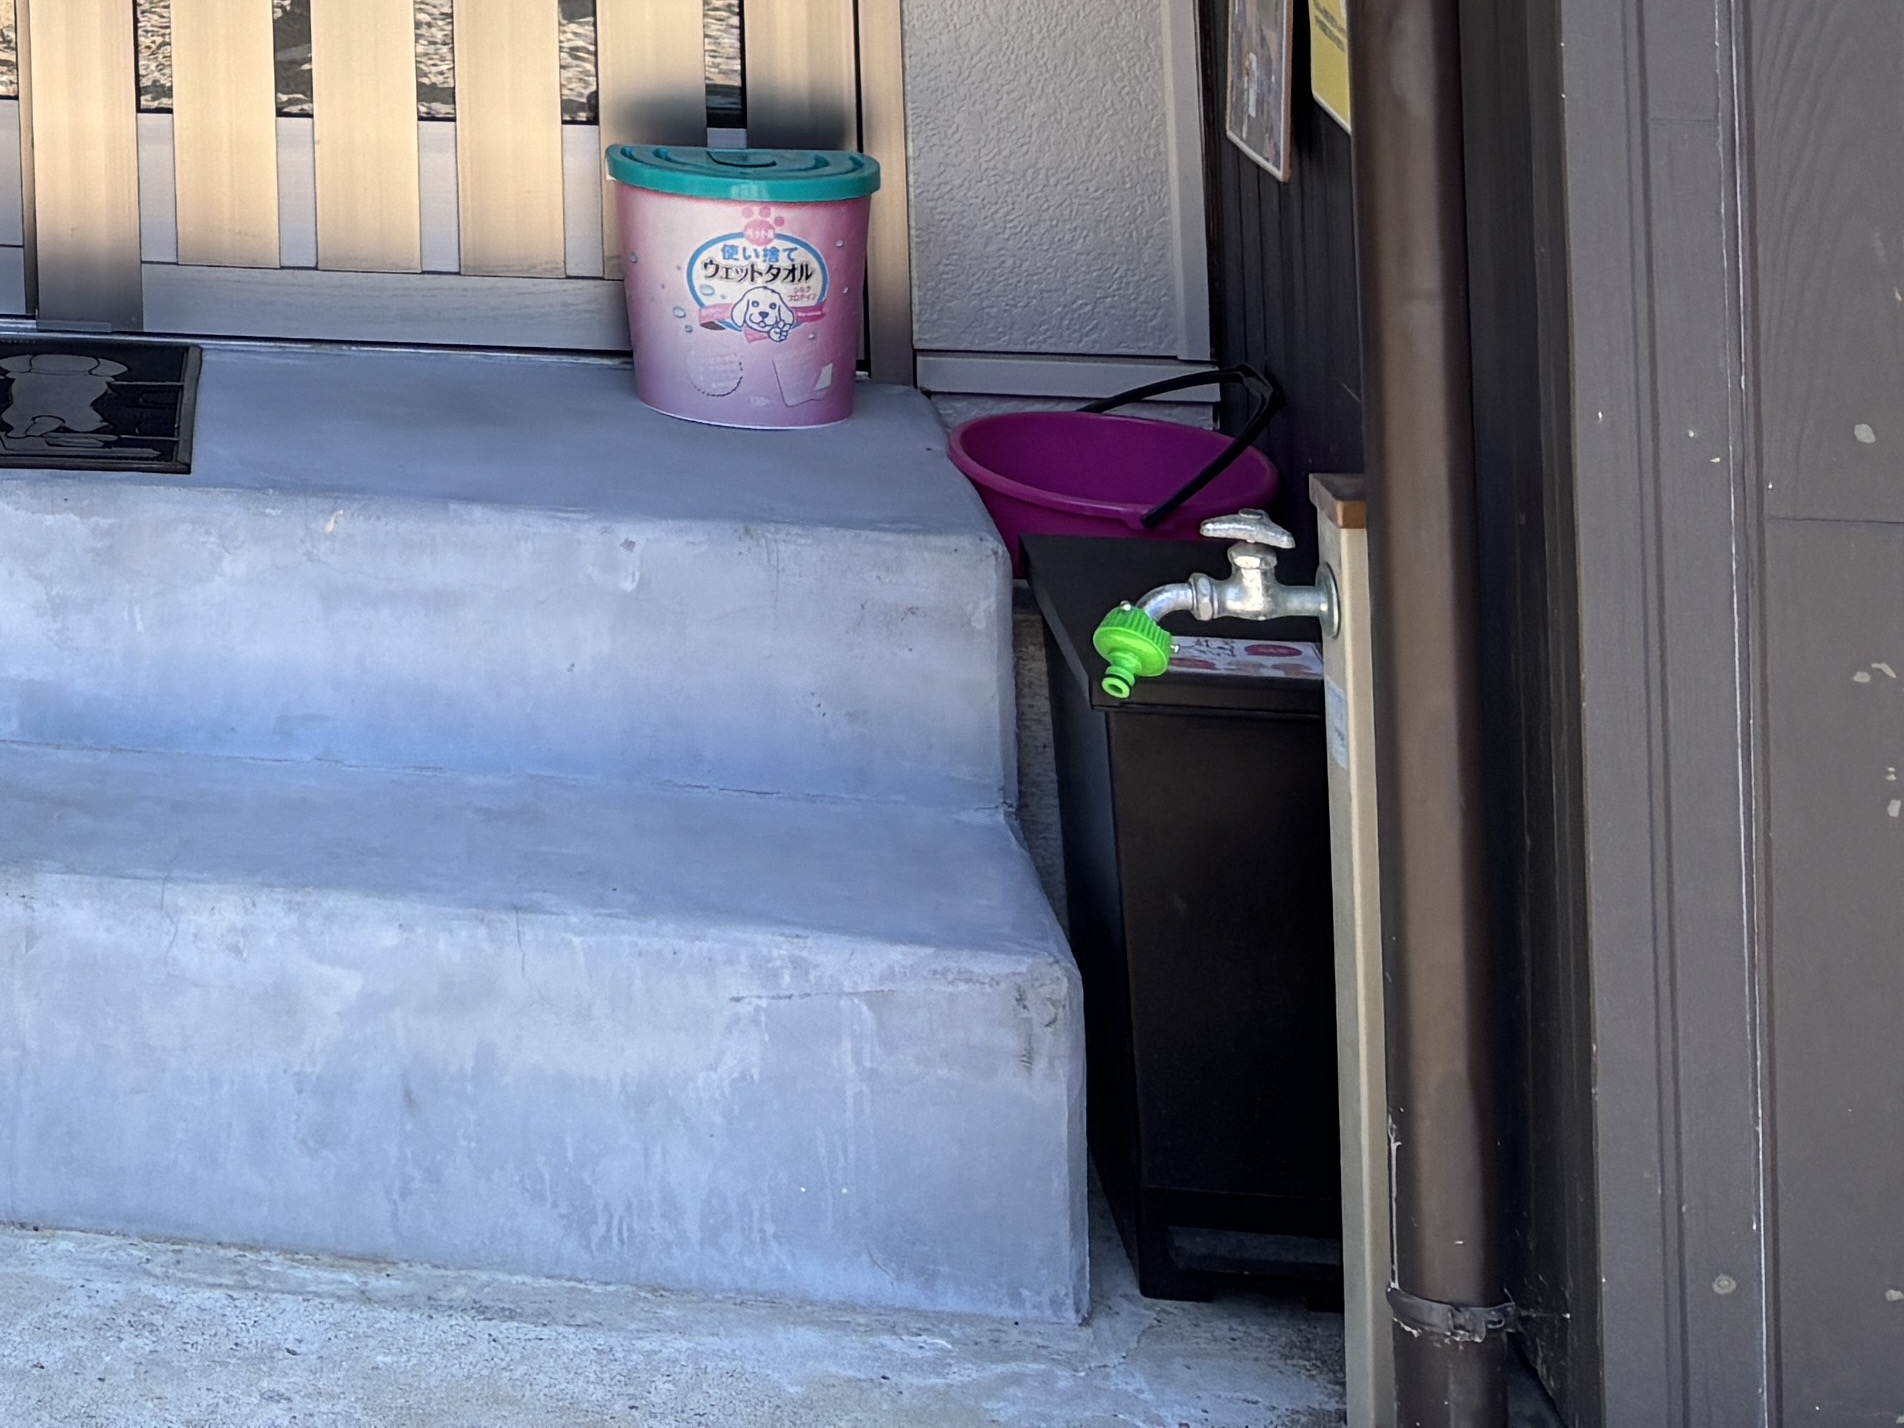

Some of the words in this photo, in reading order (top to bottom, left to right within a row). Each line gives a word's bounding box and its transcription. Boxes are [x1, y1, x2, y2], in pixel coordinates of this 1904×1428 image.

[721, 244, 799, 263] 使い捨て
[703, 259, 814, 284] ウェットタオル
